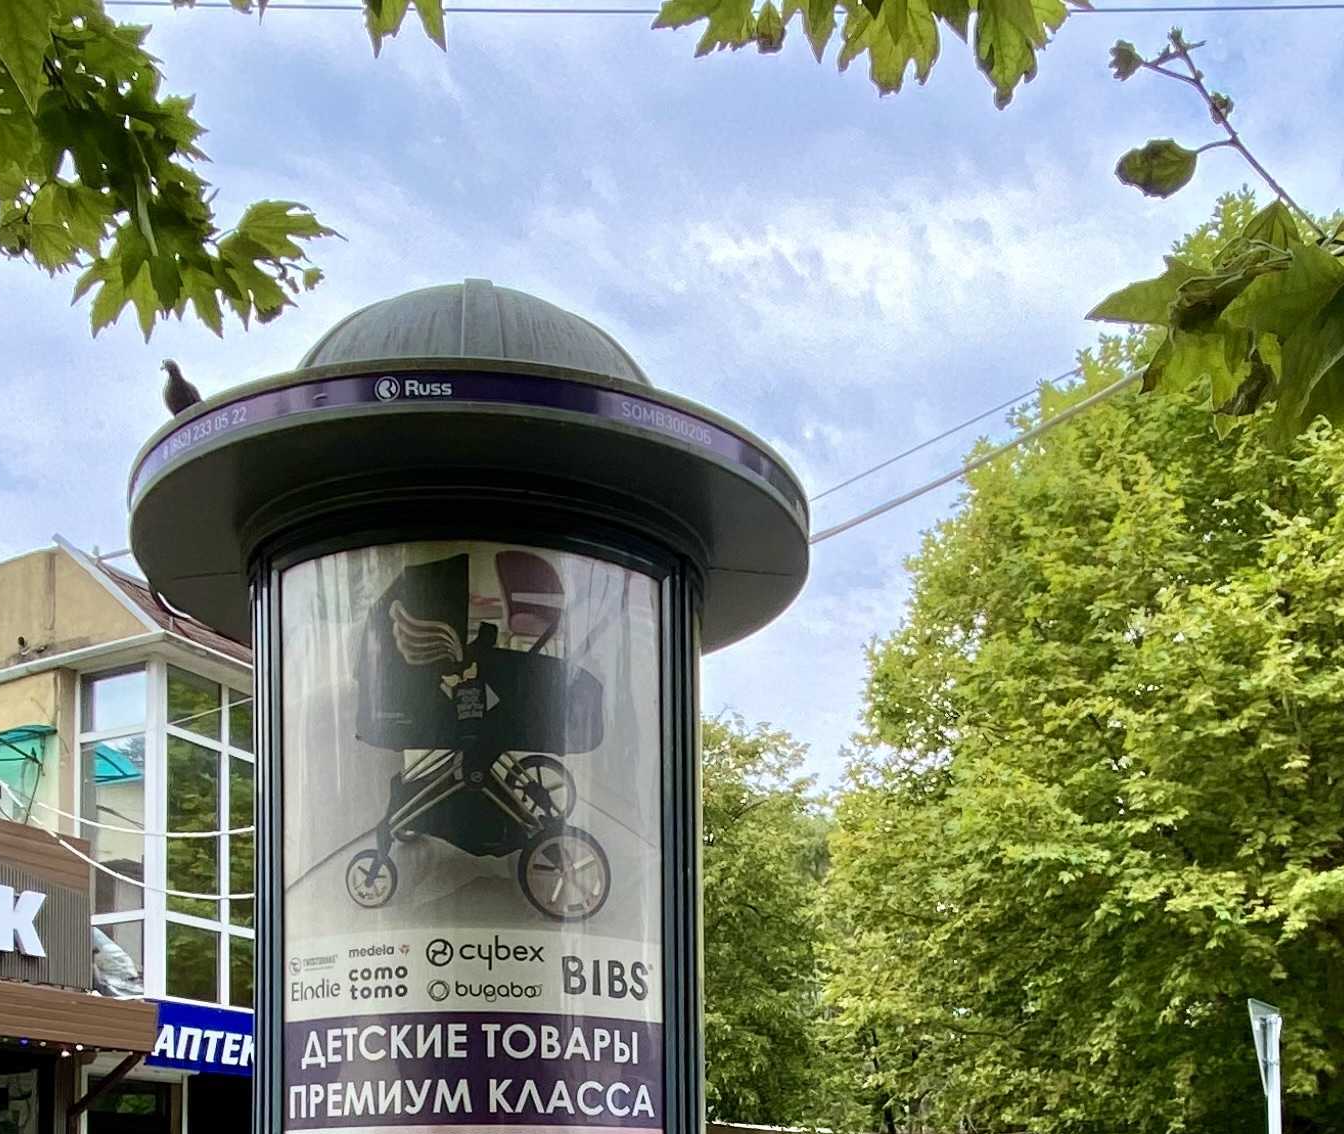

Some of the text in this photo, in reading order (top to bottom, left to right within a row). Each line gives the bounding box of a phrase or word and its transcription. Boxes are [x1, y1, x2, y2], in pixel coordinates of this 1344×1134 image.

[405, 380, 452, 396] Russ
[192, 420, 212, 441] 233
[215, 412, 230, 431] 05
[231, 406, 247, 425] 22
[348, 944, 395, 958] medela
[459, 935, 544, 971] cybex
[348, 966, 408, 981] como
[562, 956, 649, 1000] BIBS
[291, 979, 341, 1002] Elodie
[350, 984, 408, 1000] tomo
[301, 1024, 638, 1070] ДЕТСКИЕ ТОВАРЫ
[289, 1079, 655, 1119] ПРЕМИУМ КЛАССА
